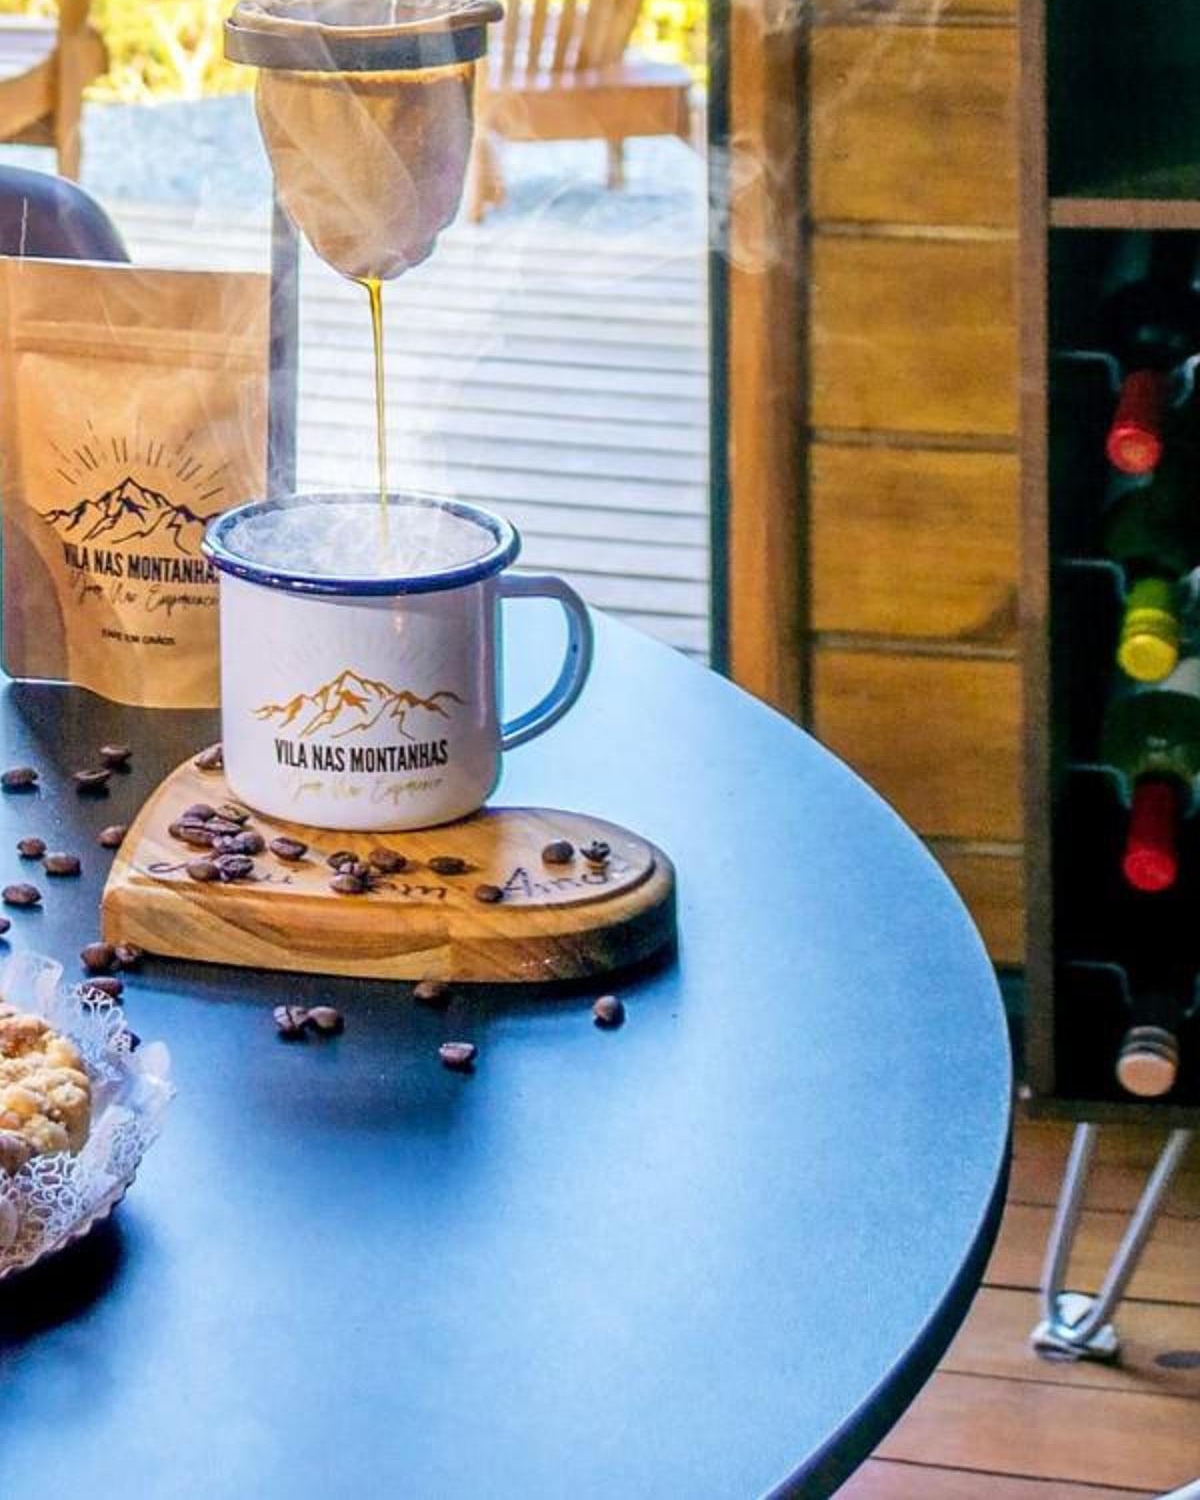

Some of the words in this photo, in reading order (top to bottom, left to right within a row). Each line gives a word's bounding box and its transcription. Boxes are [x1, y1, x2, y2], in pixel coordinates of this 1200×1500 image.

[63, 542, 90, 572] VILA
[94, 550, 123, 578] NAS
[275, 739, 308, 769] VILA
[311, 744, 345, 772] NAS
[351, 739, 449, 773] MONTANHAS
